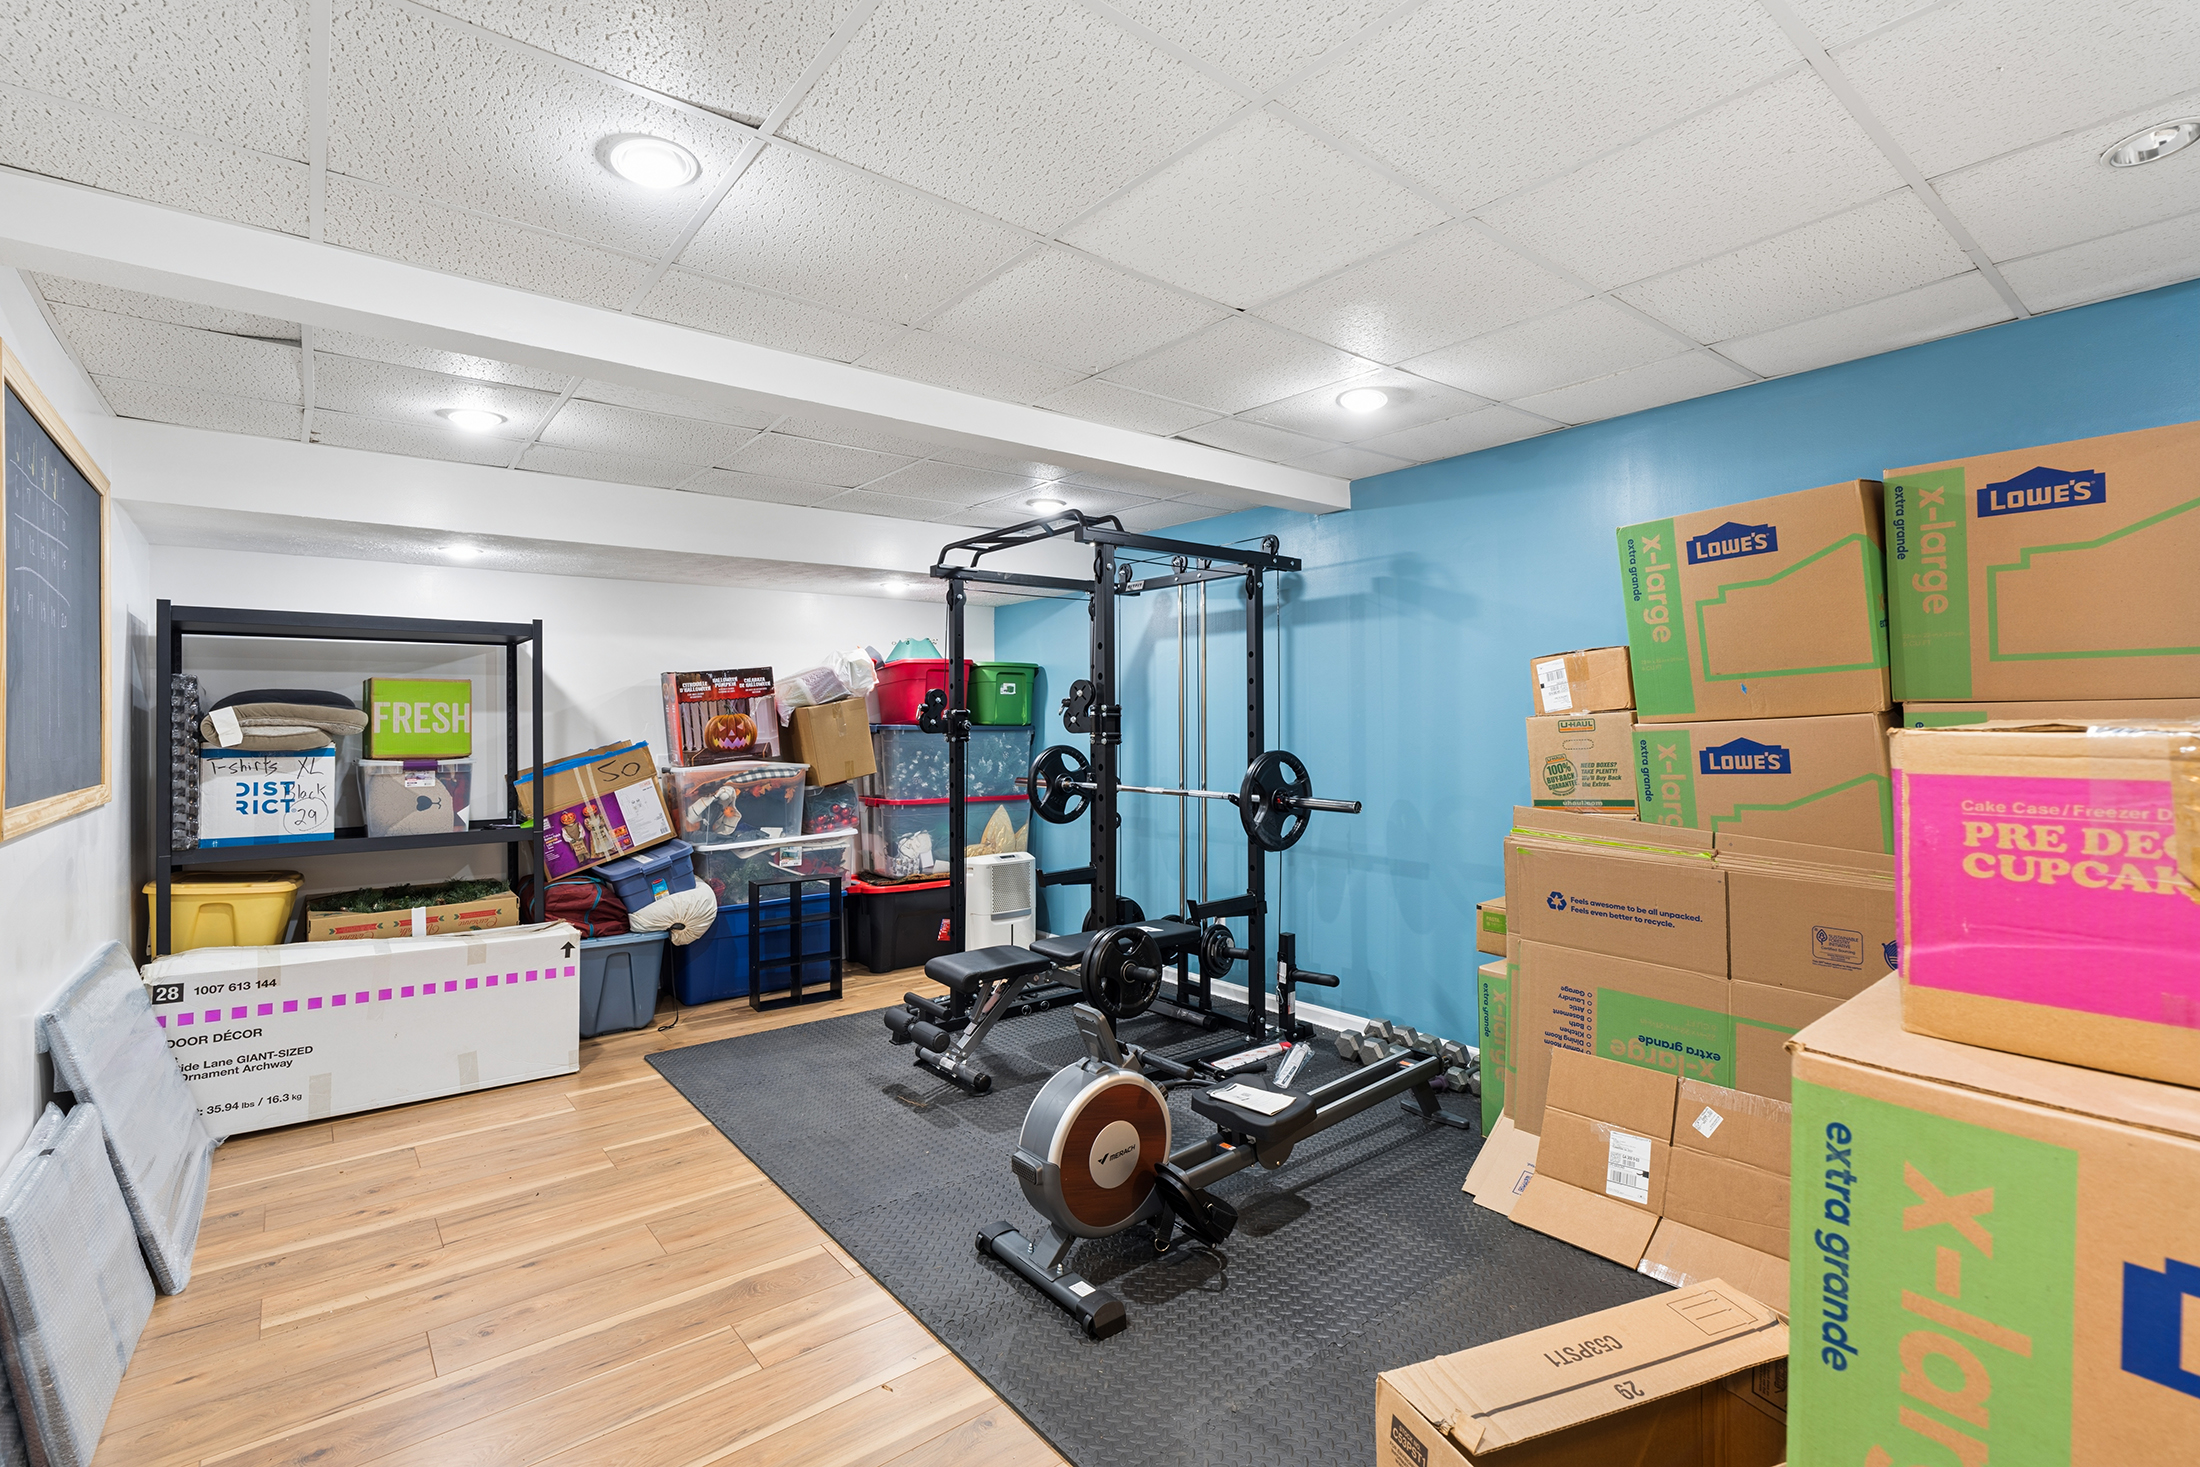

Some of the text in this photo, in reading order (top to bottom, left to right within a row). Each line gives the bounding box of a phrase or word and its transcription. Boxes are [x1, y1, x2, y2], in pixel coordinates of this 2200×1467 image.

[1990, 479, 2092, 511] LOWE'S
[1893, 485, 1909, 560] extra grande
[1696, 532, 1768, 560] LOWE'S
[1912, 485, 1957, 614] x-large
[1627, 538, 1642, 602] extra grande
[1641, 534, 1672, 643] x-large
[373, 701, 470, 734] FRESH
[1560, 720, 1593, 729] U-HAUL
[206, 755, 325, 780] T-shirts XL
[1546, 761, 1571, 776] 100%
[1639, 739, 1654, 802] extra grande
[1708, 752, 1782, 770] LOWE'S
[284, 782, 327, 800] Black
[294, 808, 317, 826] 29
[1961, 800, 2007, 813] Cake
[2012, 801, 2060, 815] Case
[2073, 804, 2150, 820] Freezer
[1962, 821, 2068, 853] PRE
[1570, 897, 1703, 923] Feels awesome to be all unpacked.
[1570, 906, 1589, 915] Feels
[1590, 910, 1608, 918] even
[1609, 912, 1633, 922] better
[1644, 918, 1675, 928] recycle.
[155, 979, 277, 1002] 28 1007 613 144
[1558, 993, 1585, 1005] Laundry
[1560, 985, 1585, 997] Garage
[1552, 1008, 1585, 1022] Basement
[1569, 1004, 1585, 1013] Attic
[1483, 1008, 1492, 1038] grande
[1559, 1026, 1585, 1038] Kitchen
[1568, 1020, 1585, 1030] Bath
[213, 1028, 263, 1044] DÉCOR
[1544, 1031, 1585, 1047] Dining Room
[1638, 1034, 1722, 1061] extra grande
[178, 1045, 314, 1073] ide Lane GIANT-SIZED
[242, 1059, 293, 1074] Archway
[1610, 1037, 1716, 1080] x-large
[206, 1101, 240, 1115] 35.94
[241, 1101, 255, 1110] lbs
[267, 1093, 290, 1105] 16.3
[291, 1093, 302, 1101] kg
[1109, 1144, 1136, 1161] MERACH
[1814, 1121, 1859, 1372] extra grande
[1864, 1160, 2033, 1467] x-lar
[1544, 1335, 1623, 1368] C53PST1
[1613, 1380, 1646, 1400] 29
[1392, 1427, 1426, 1467] C53PST1
